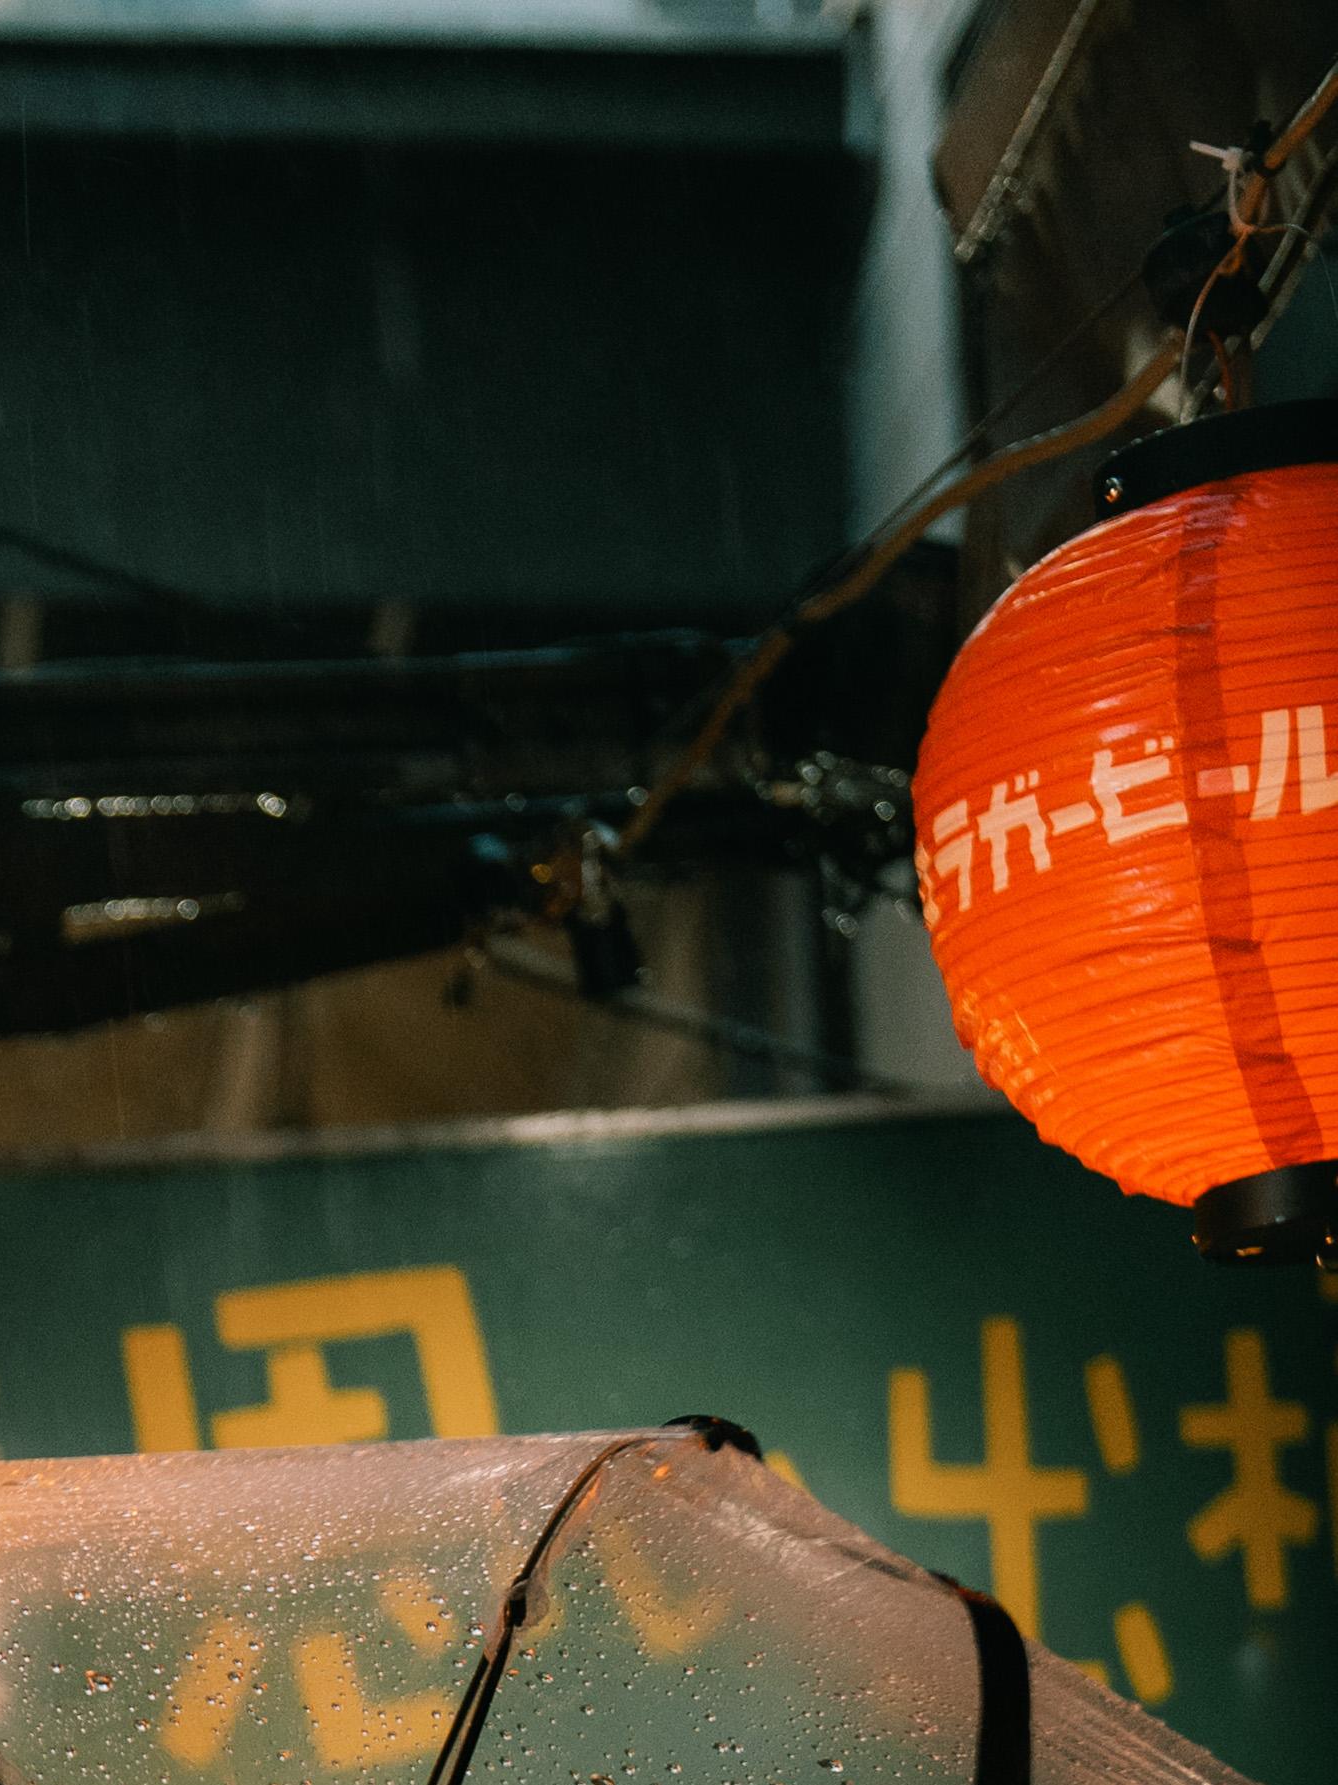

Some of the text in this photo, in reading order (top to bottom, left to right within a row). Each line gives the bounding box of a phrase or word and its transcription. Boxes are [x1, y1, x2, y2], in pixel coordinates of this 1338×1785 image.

[914, 704, 1338, 928] ラガービール
